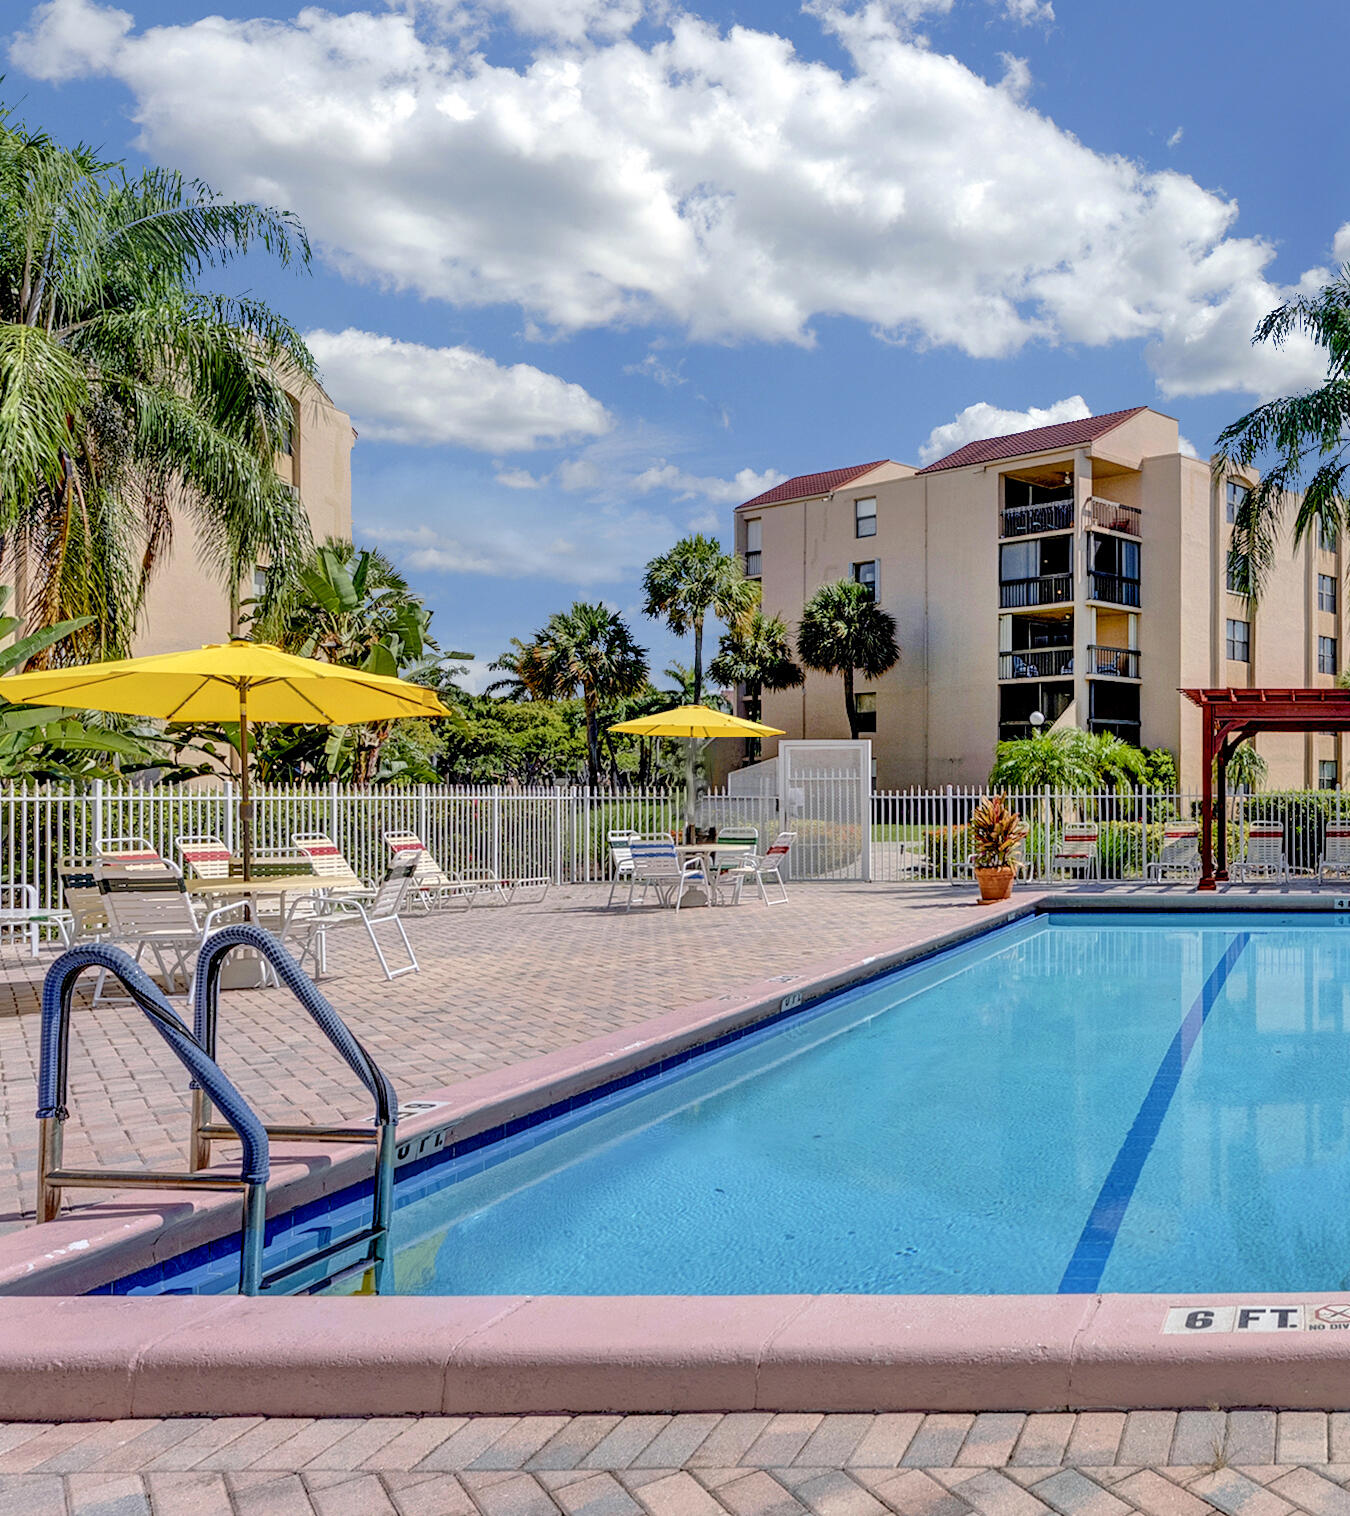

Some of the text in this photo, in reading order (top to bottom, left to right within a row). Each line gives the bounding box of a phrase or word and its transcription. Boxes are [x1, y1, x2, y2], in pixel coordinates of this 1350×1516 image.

[1337, 900, 1344, 908] 4
[1184, 1308, 1298, 1329] 6 FT.
[1309, 1323, 1326, 1331] NO
